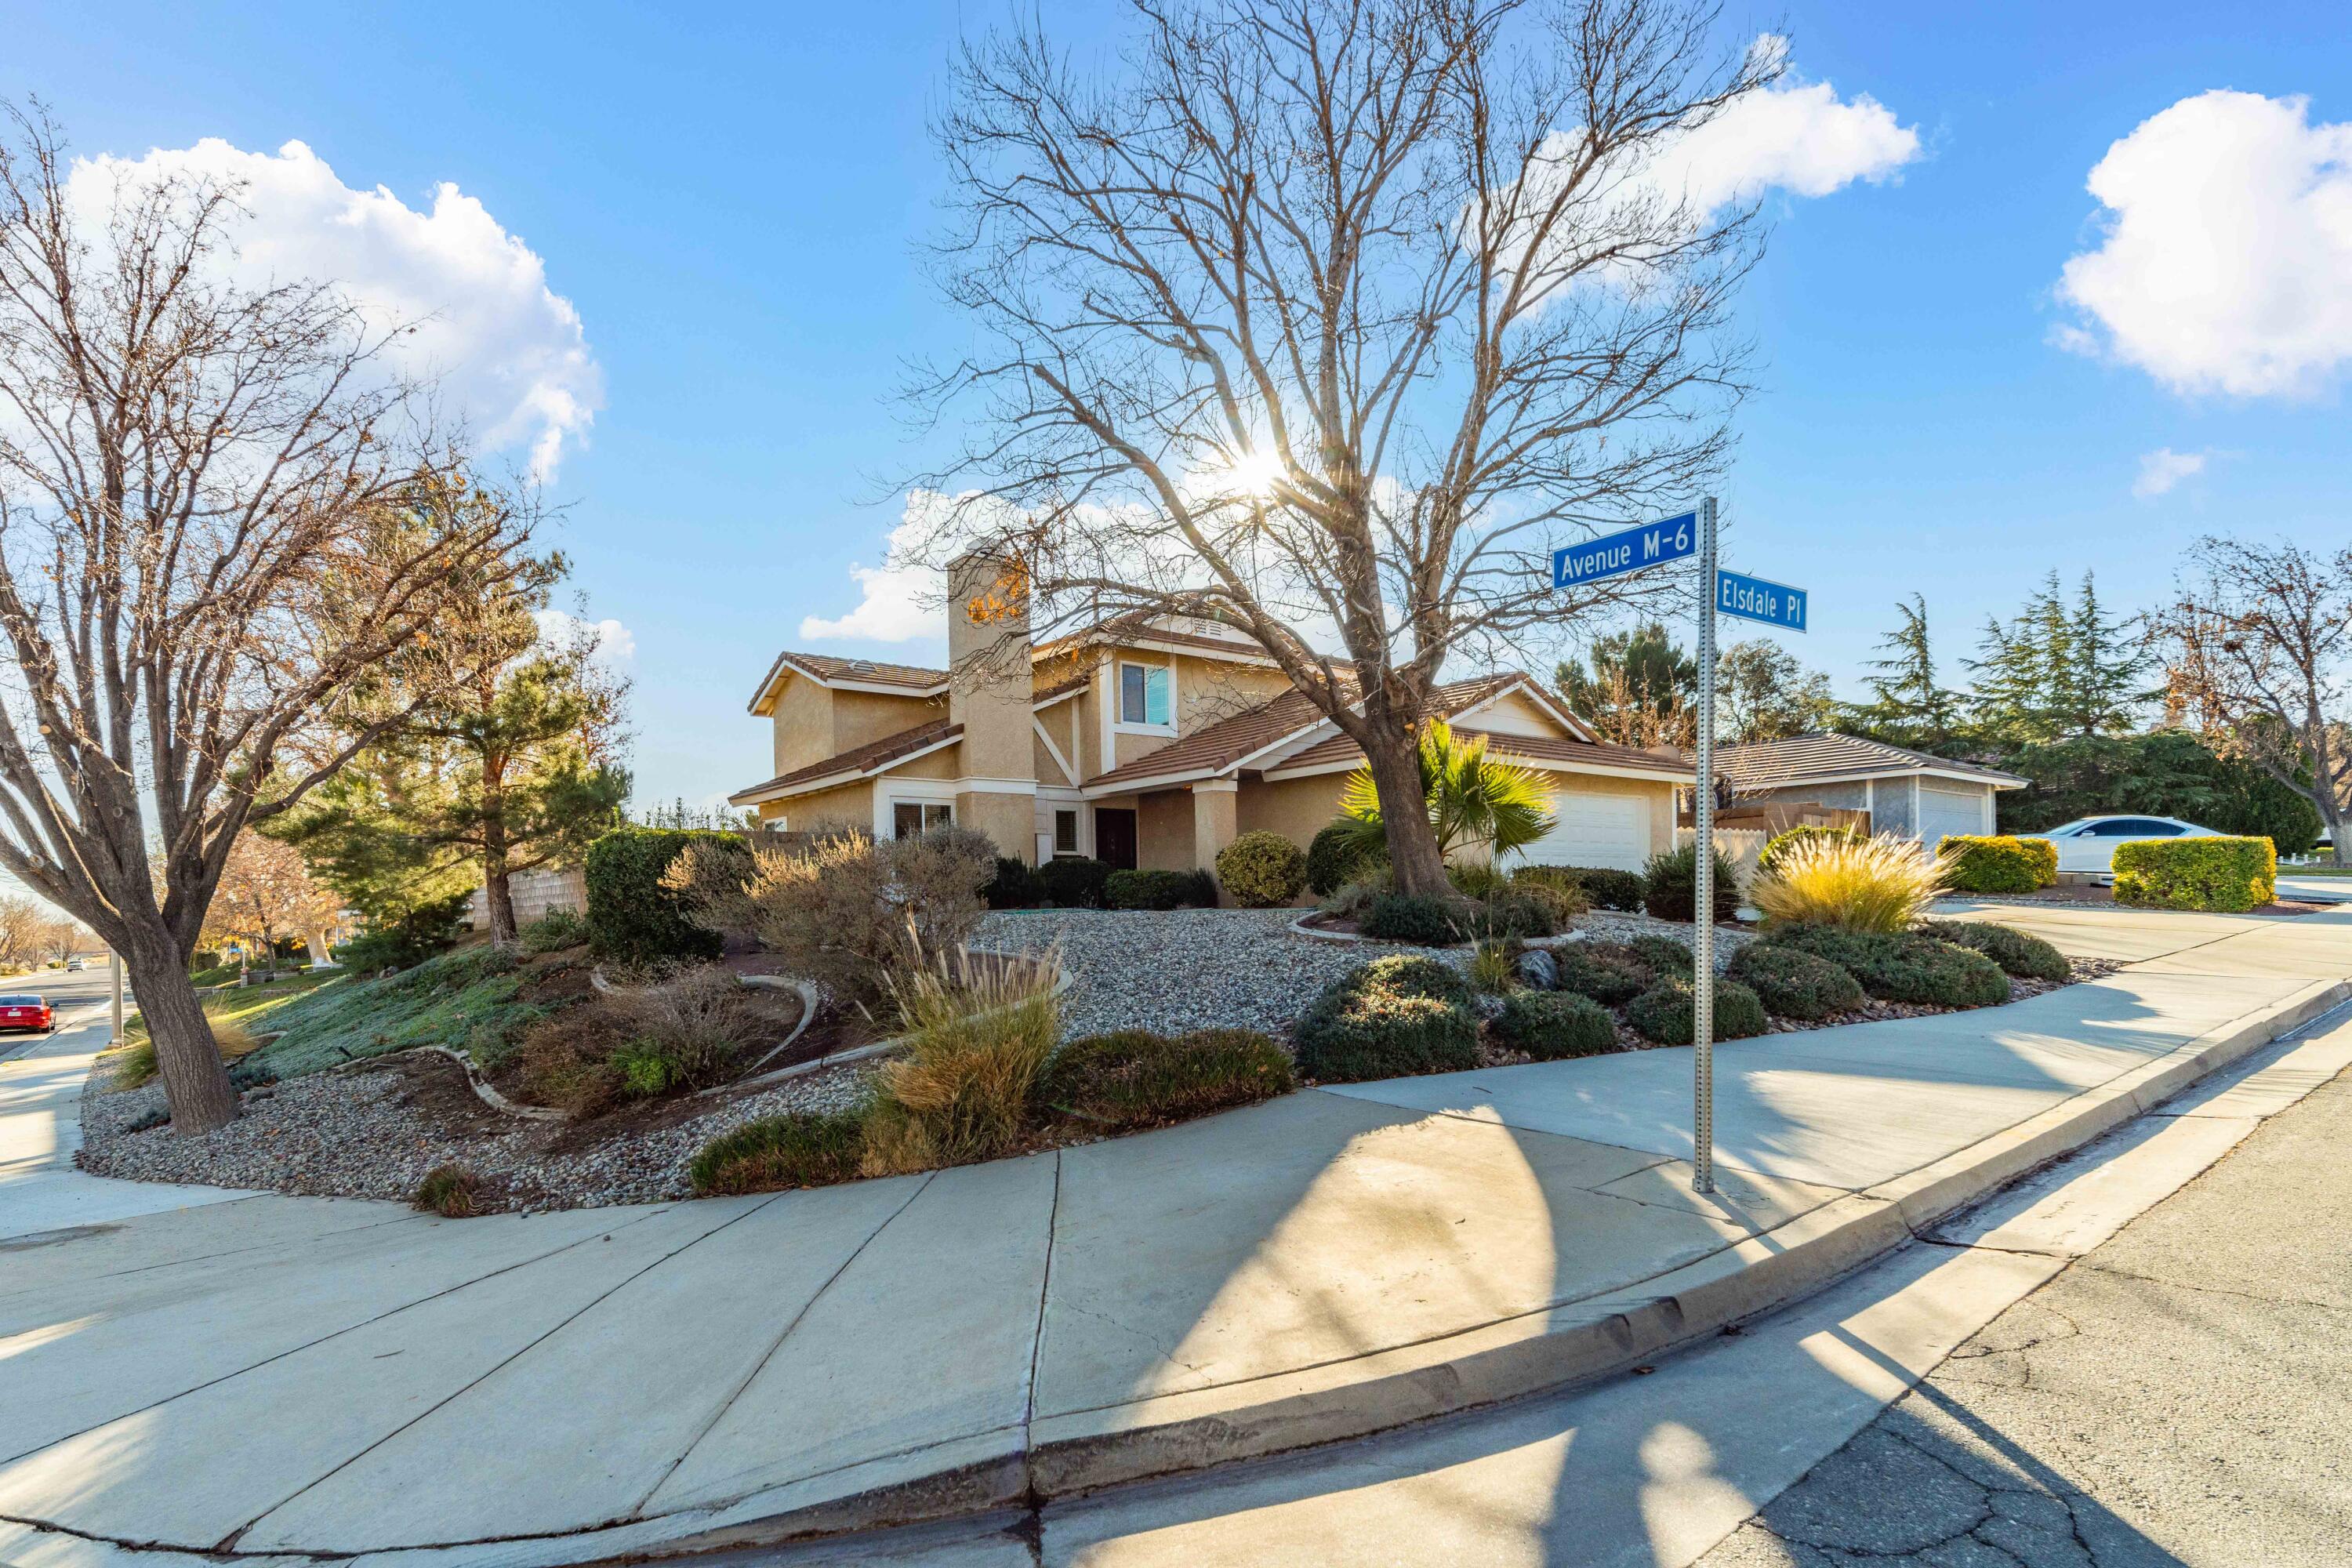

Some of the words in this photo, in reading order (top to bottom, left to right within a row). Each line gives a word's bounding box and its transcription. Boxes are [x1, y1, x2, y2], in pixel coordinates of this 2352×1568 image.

[1561, 545, 1631, 581] Avenue
[1644, 524, 1689, 560] M-6
[1722, 579, 1777, 617] Elsdale
[1788, 595, 1801, 623] Pl
